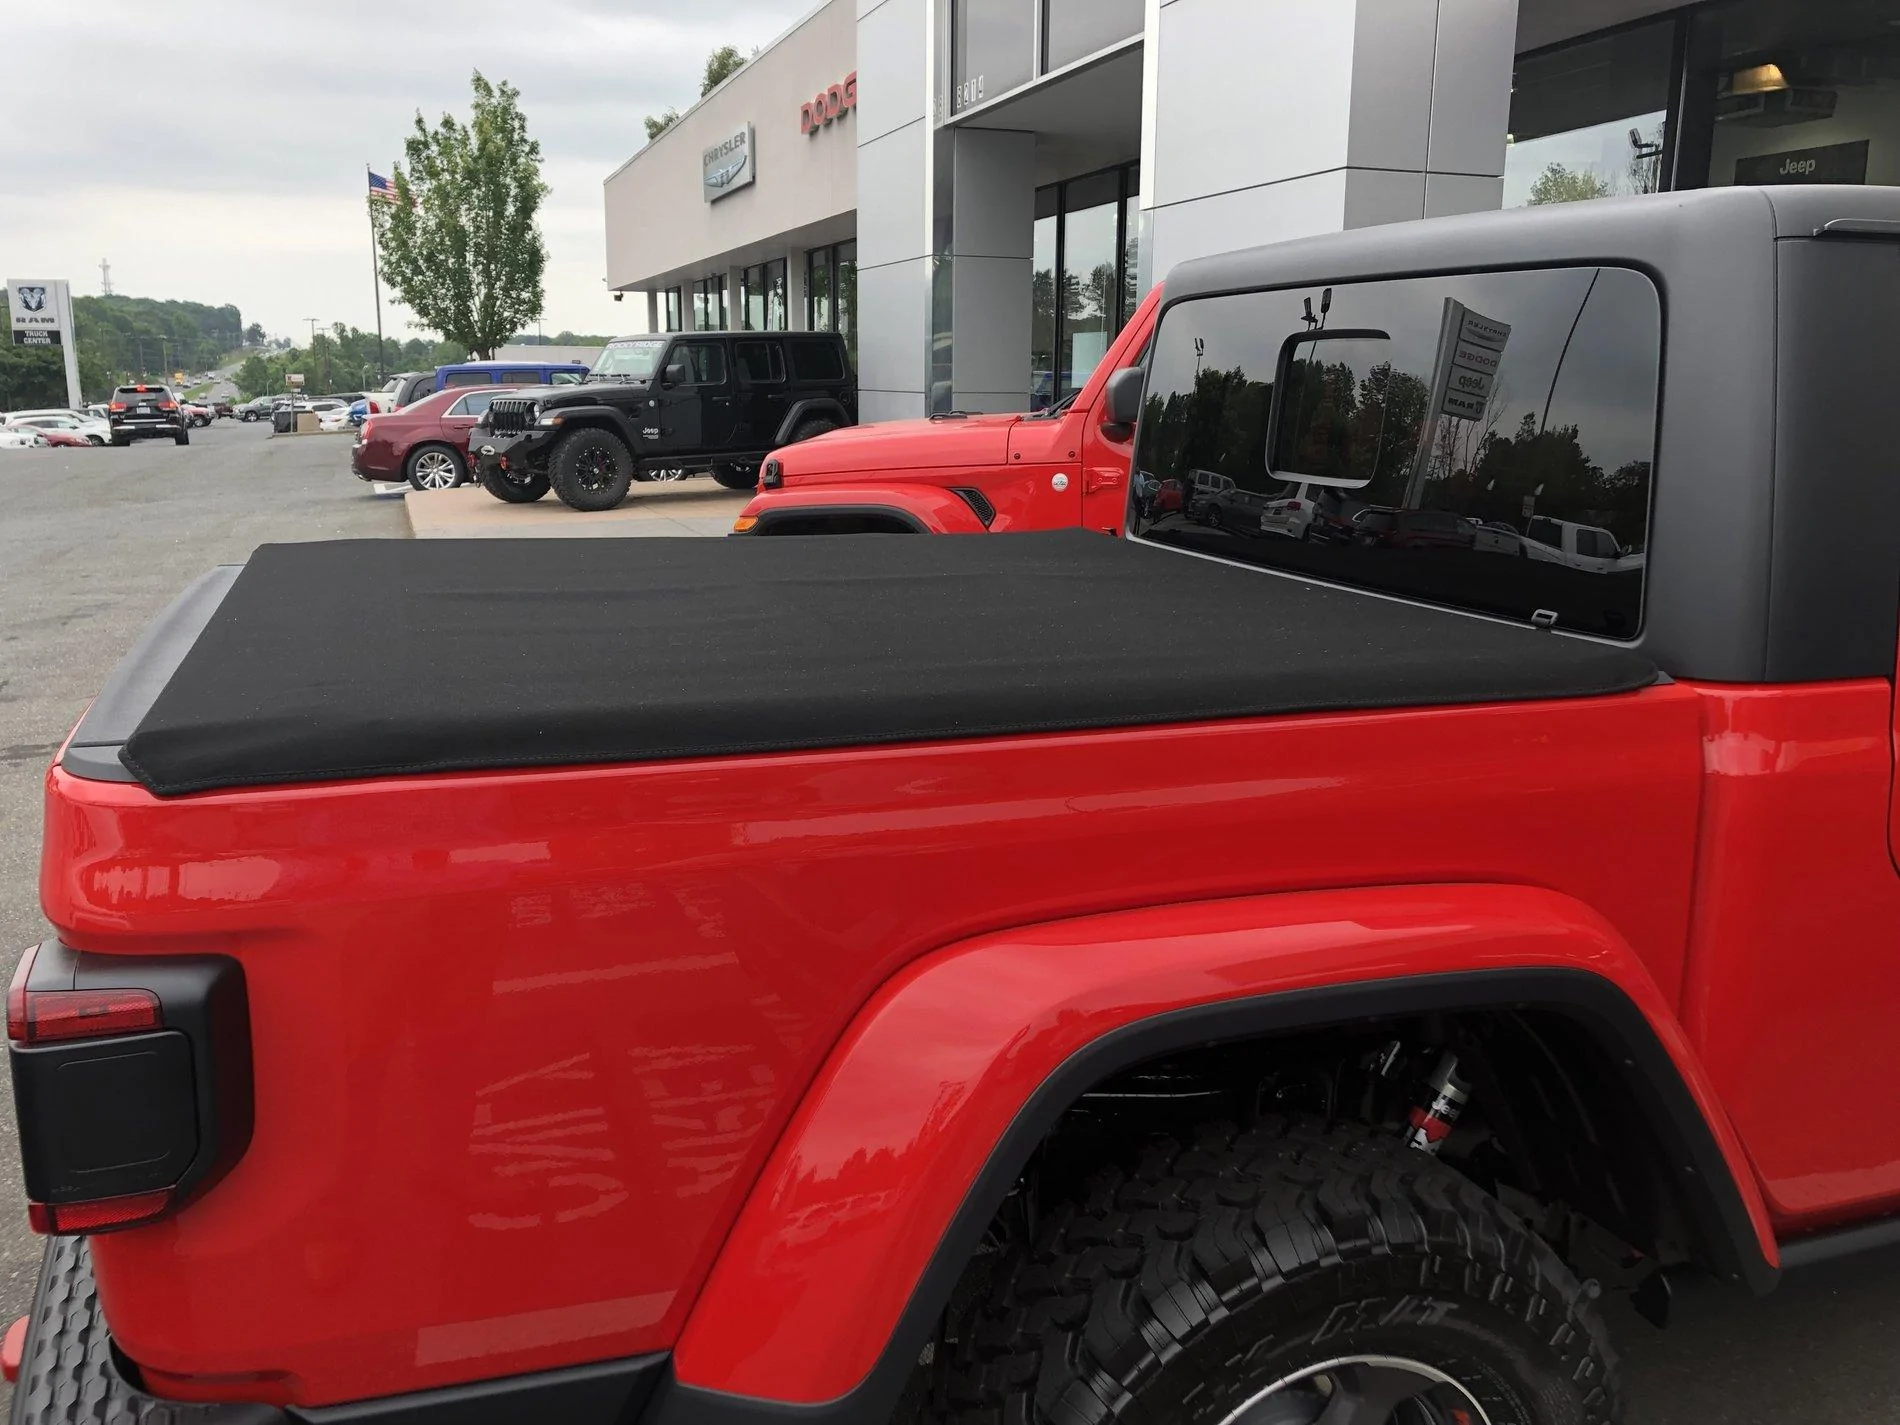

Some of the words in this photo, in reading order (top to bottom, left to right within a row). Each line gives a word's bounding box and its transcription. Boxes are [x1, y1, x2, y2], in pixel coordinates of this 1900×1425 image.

[703, 131, 746, 167] CHRYSLER
[1779, 158, 1817, 175] Jeep
[15, 316, 55, 324] RAM
